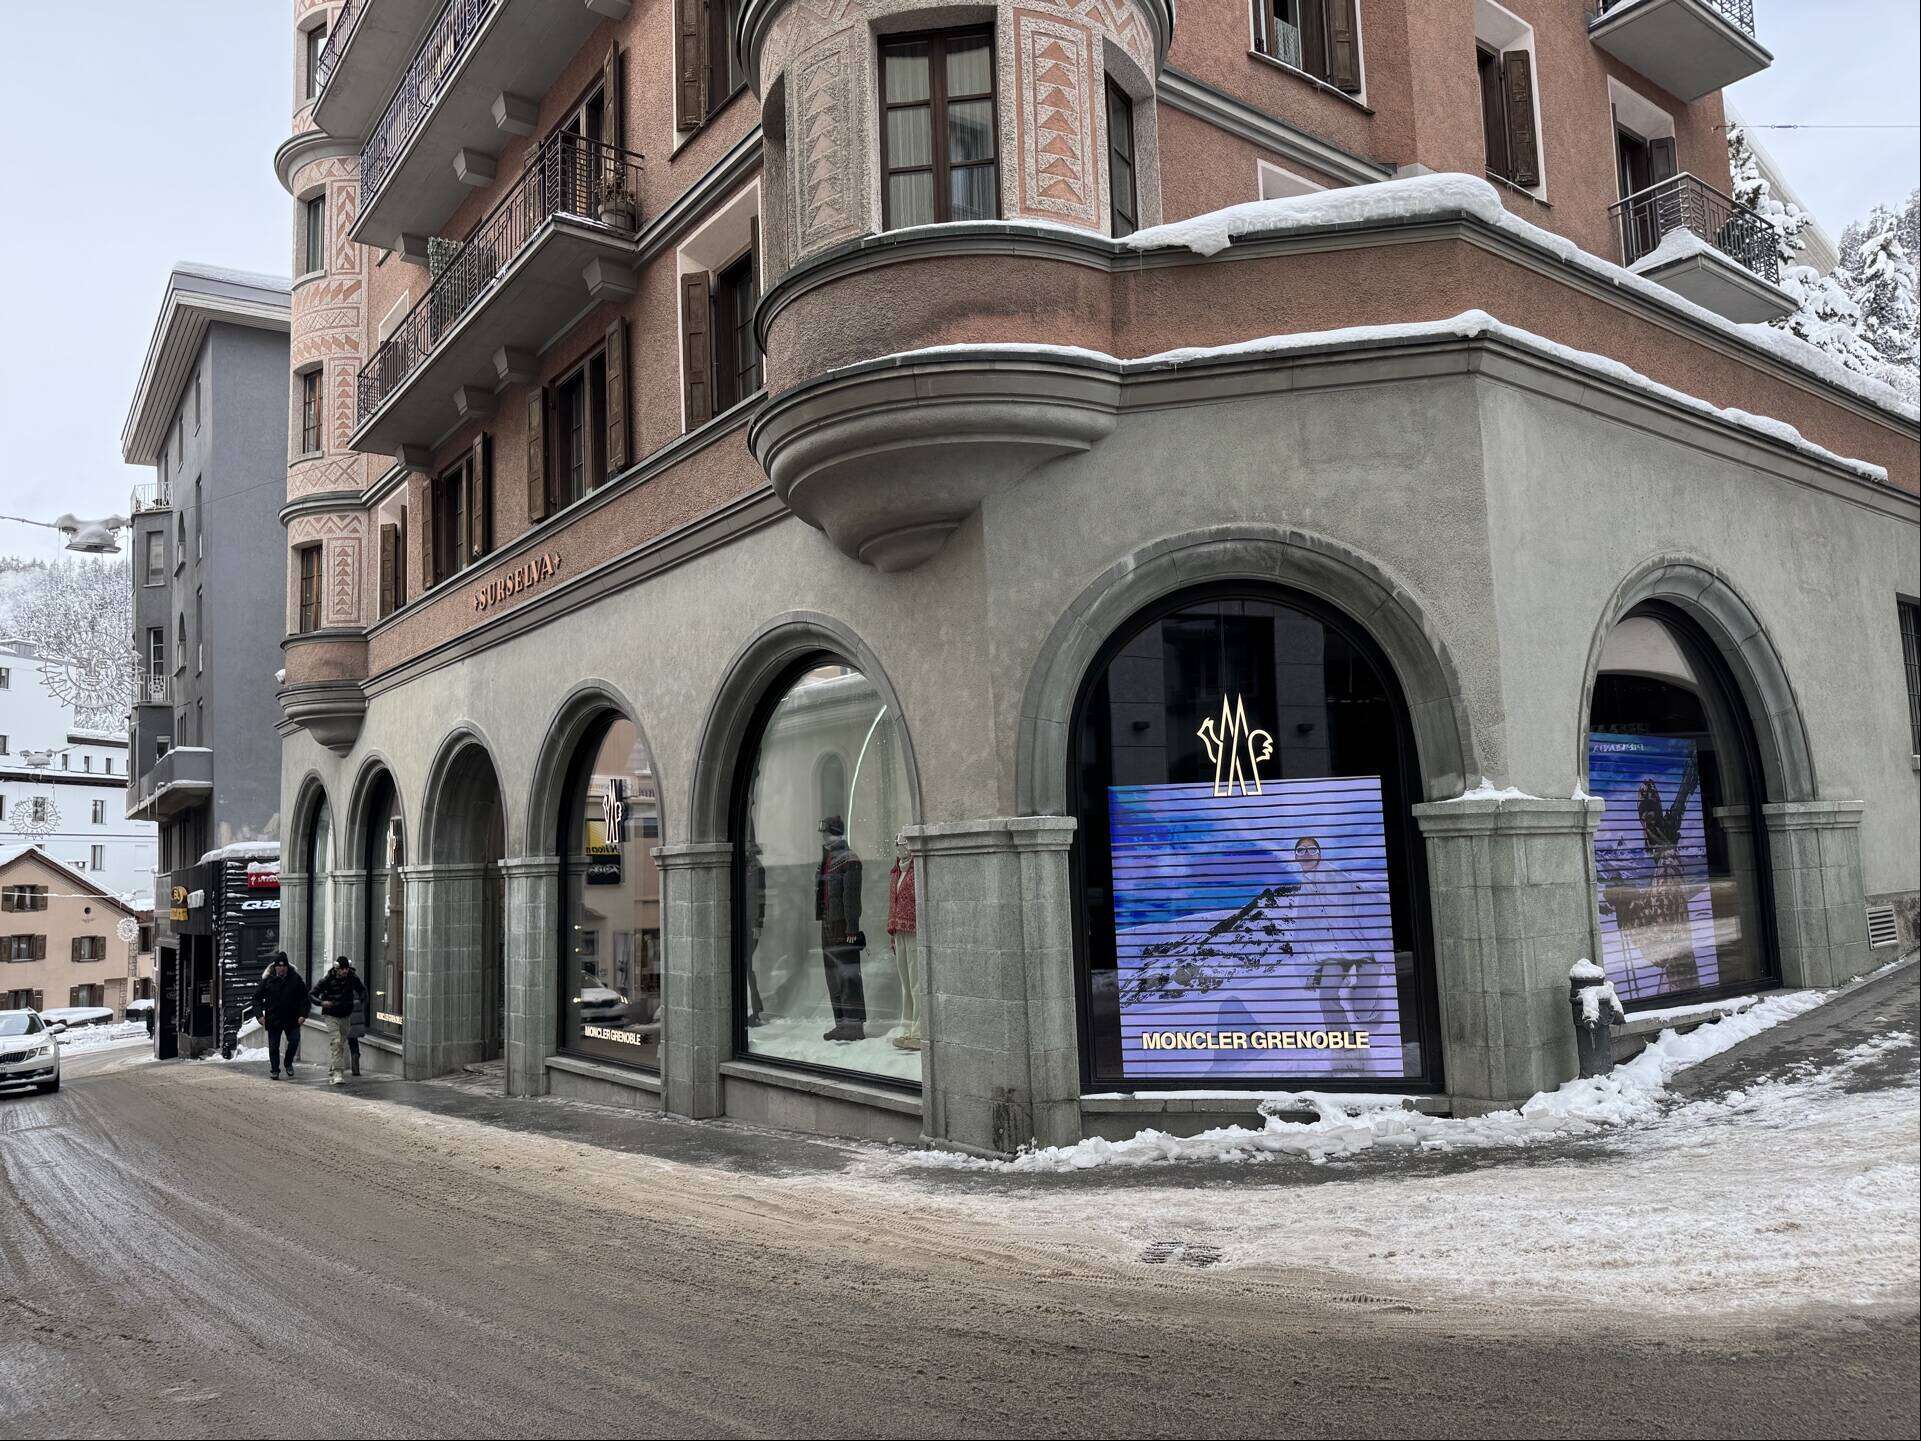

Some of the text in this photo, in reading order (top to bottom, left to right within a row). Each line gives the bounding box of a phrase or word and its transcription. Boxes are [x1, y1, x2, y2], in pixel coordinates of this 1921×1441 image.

[480, 553, 555, 610] SURSELVA
[584, 1025, 641, 1046] MONCLER GRENOBLE
[1142, 1031, 1370, 1050] MONCLER GRENOBLE
